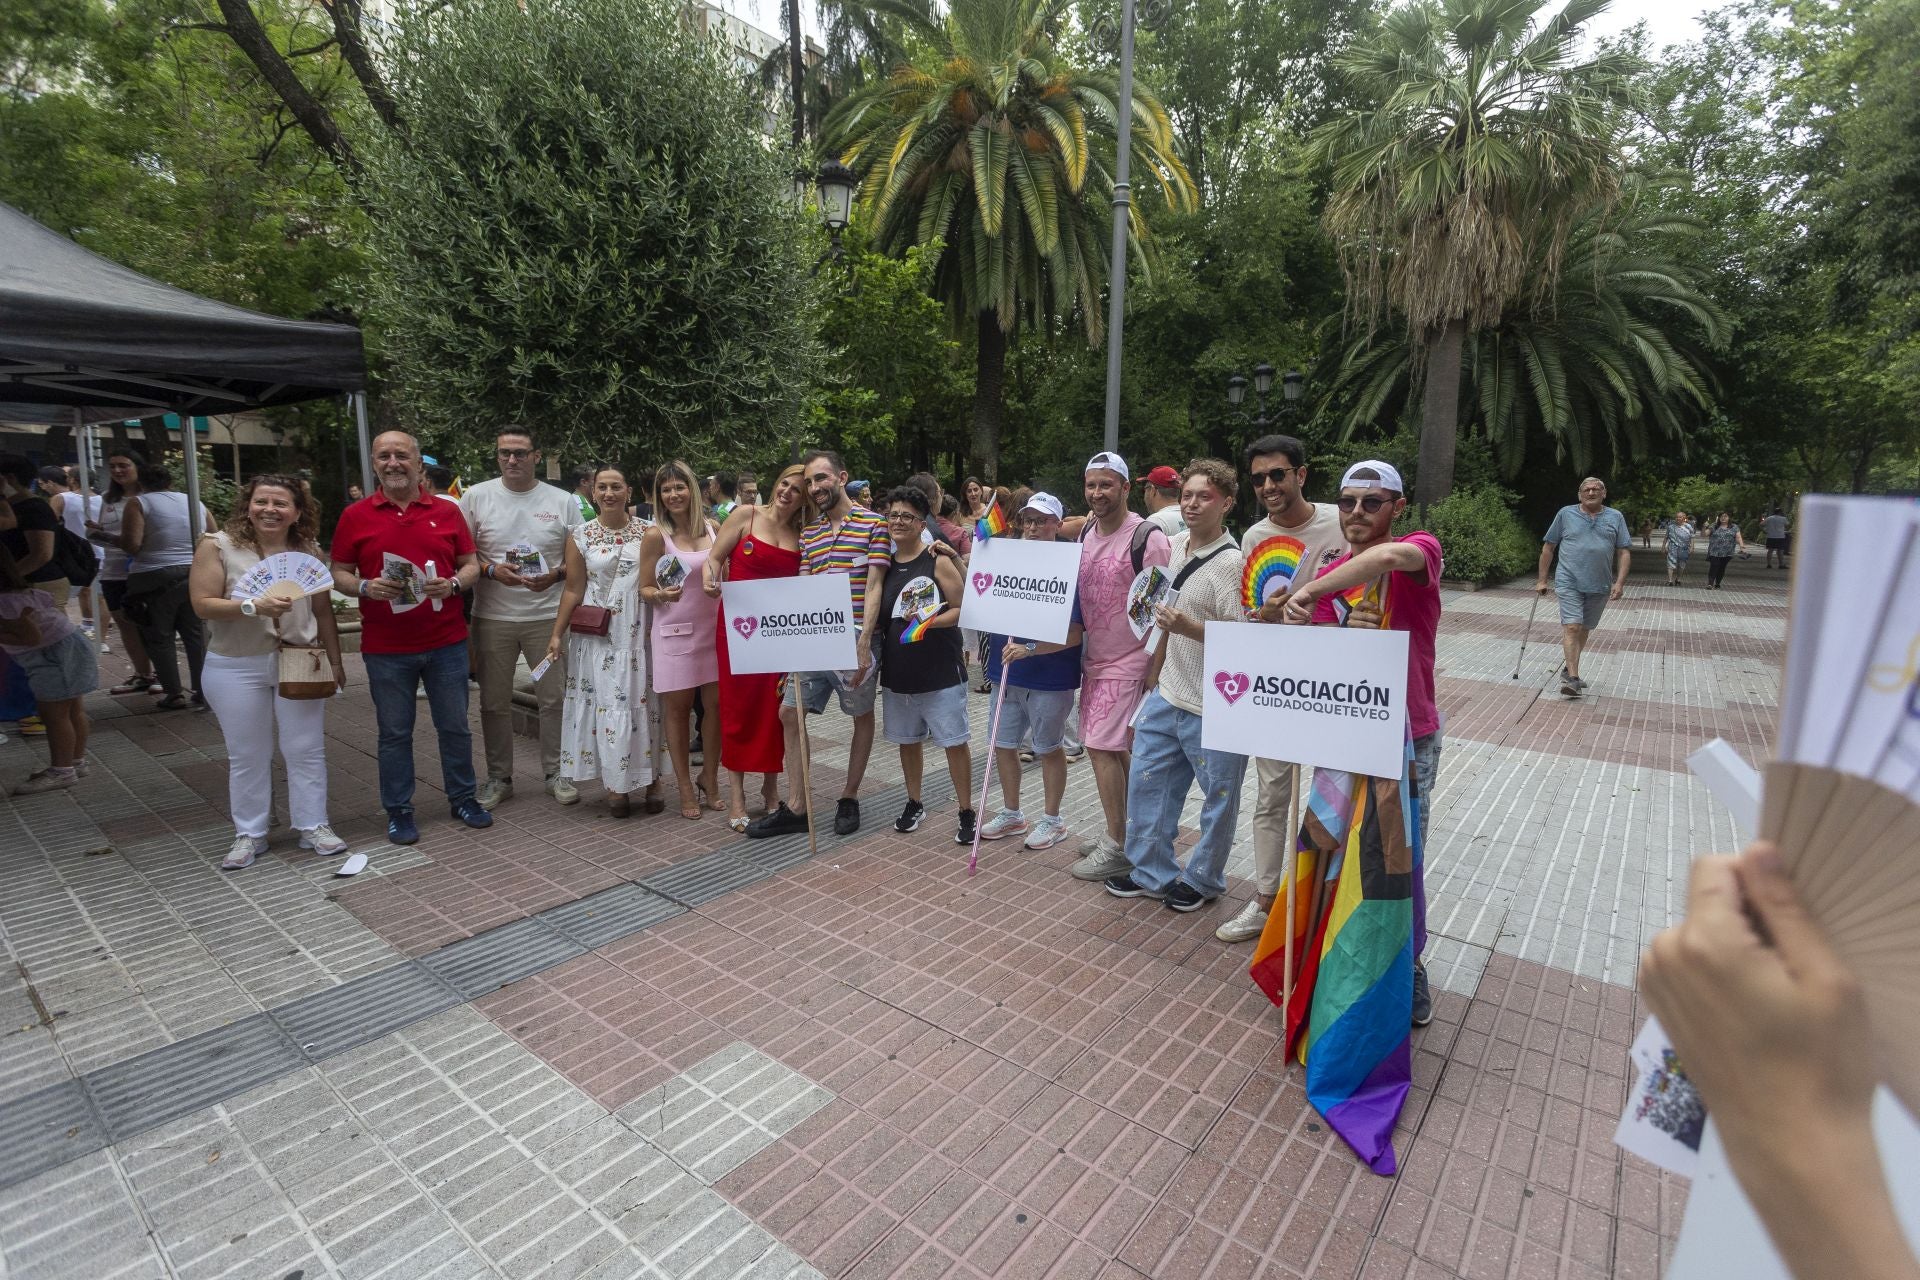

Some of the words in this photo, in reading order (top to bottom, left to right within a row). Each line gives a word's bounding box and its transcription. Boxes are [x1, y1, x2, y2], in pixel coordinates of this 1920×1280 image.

[994, 574, 1068, 595] ASOCIACIÓN
[992, 588, 1066, 605] CUIDADOQUETEVEO
[760, 608, 845, 629] ASOCIACIÓN
[761, 625, 846, 638] CUIDADOQUETEVEO
[1252, 675, 1390, 708] ASOCIACIÓN
[1252, 695, 1391, 721] CUIDADOQUETEVEO
